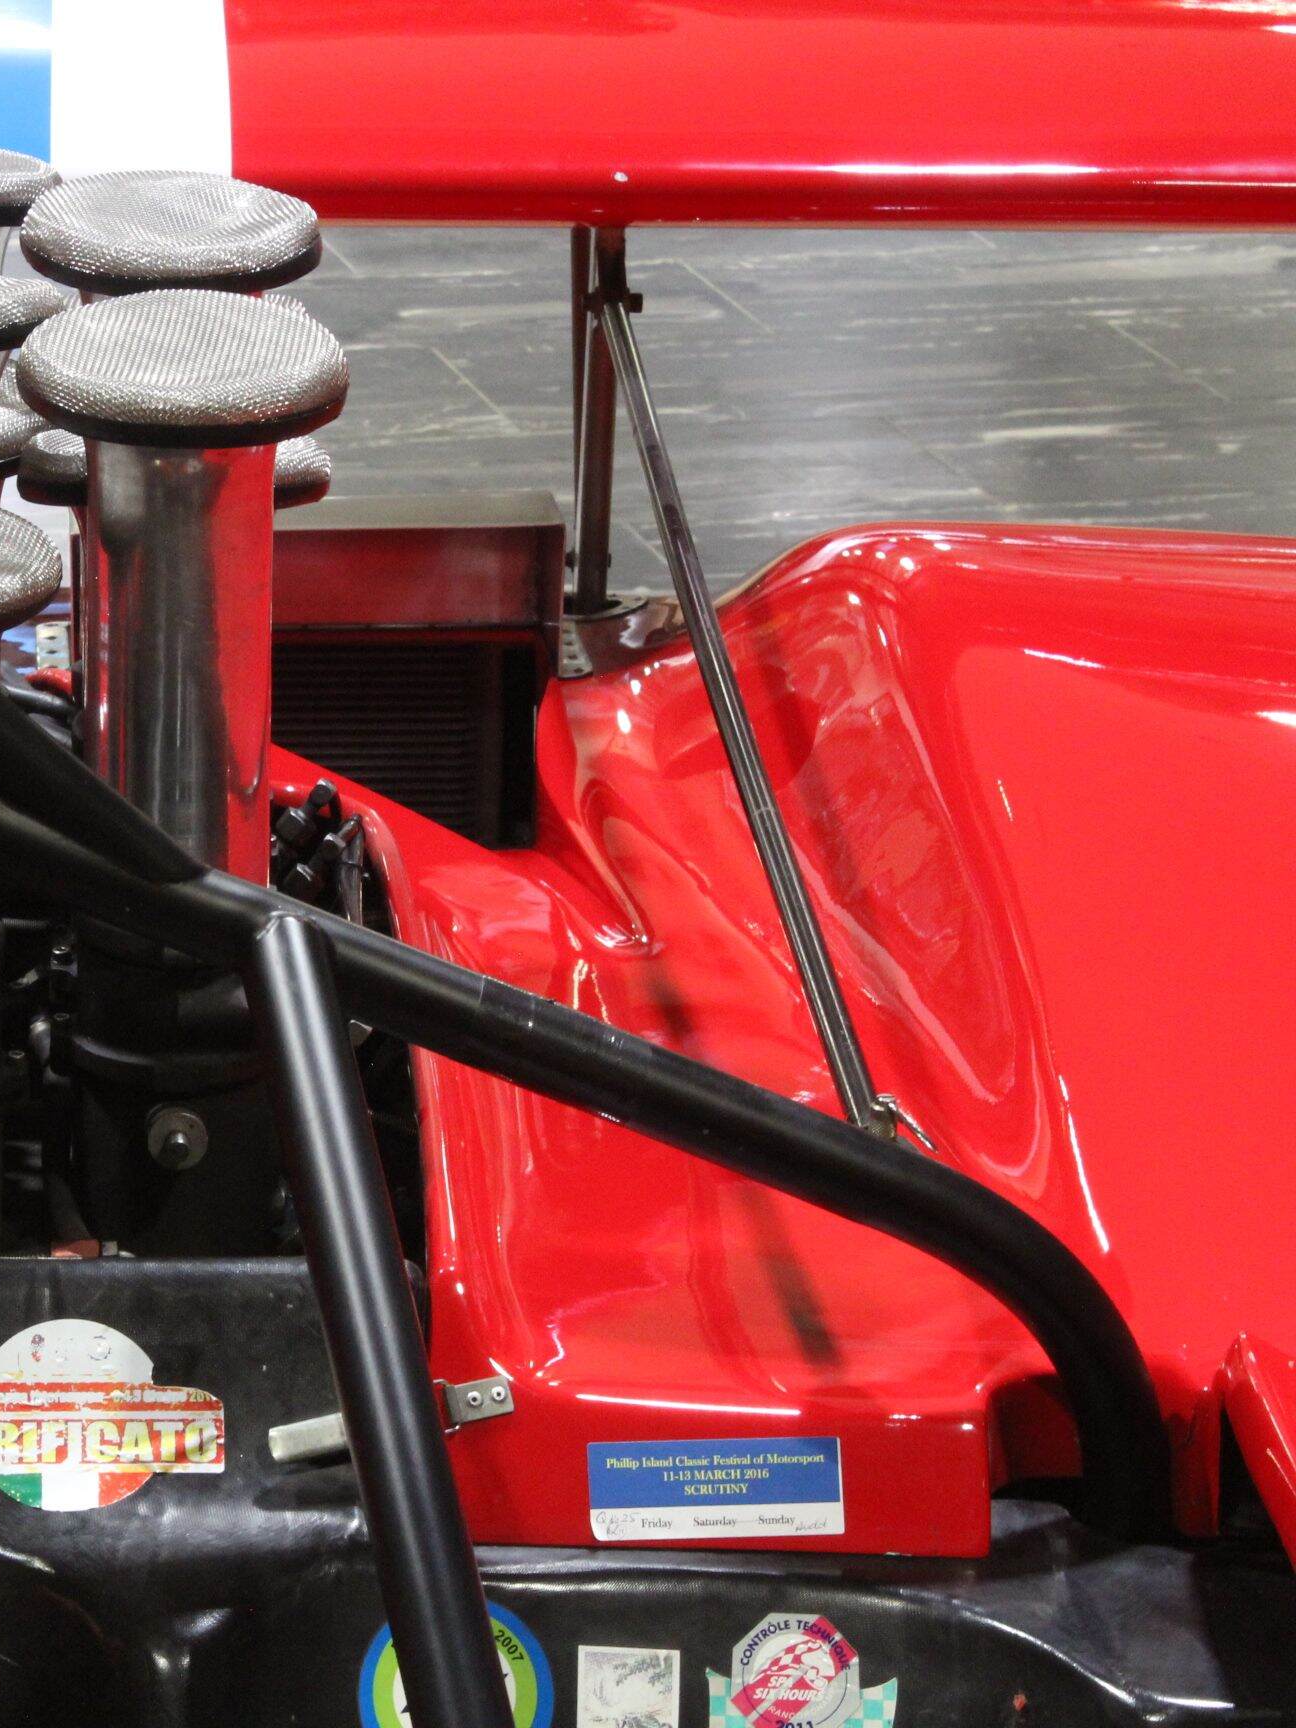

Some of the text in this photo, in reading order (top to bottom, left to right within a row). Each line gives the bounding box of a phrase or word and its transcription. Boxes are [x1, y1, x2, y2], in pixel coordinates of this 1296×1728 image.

[606, 1453, 825, 1470] Phillip Island Classic Festival of Motorsport
[663, 1468, 770, 1482] 11-13 MARCH 2016
[684, 1483, 749, 1496] SCRUTINY
[641, 1518, 673, 1529] Friday
[693, 1515, 738, 1528] Saturday
[758, 1513, 796, 1526] Sunday
[494, 1629, 525, 1662] 2007
[740, 1619, 851, 1671] CONTRÔLE TECHNIQUE
[767, 1675, 794, 1688] SPA
[778, 1688, 825, 1702] HOURS
